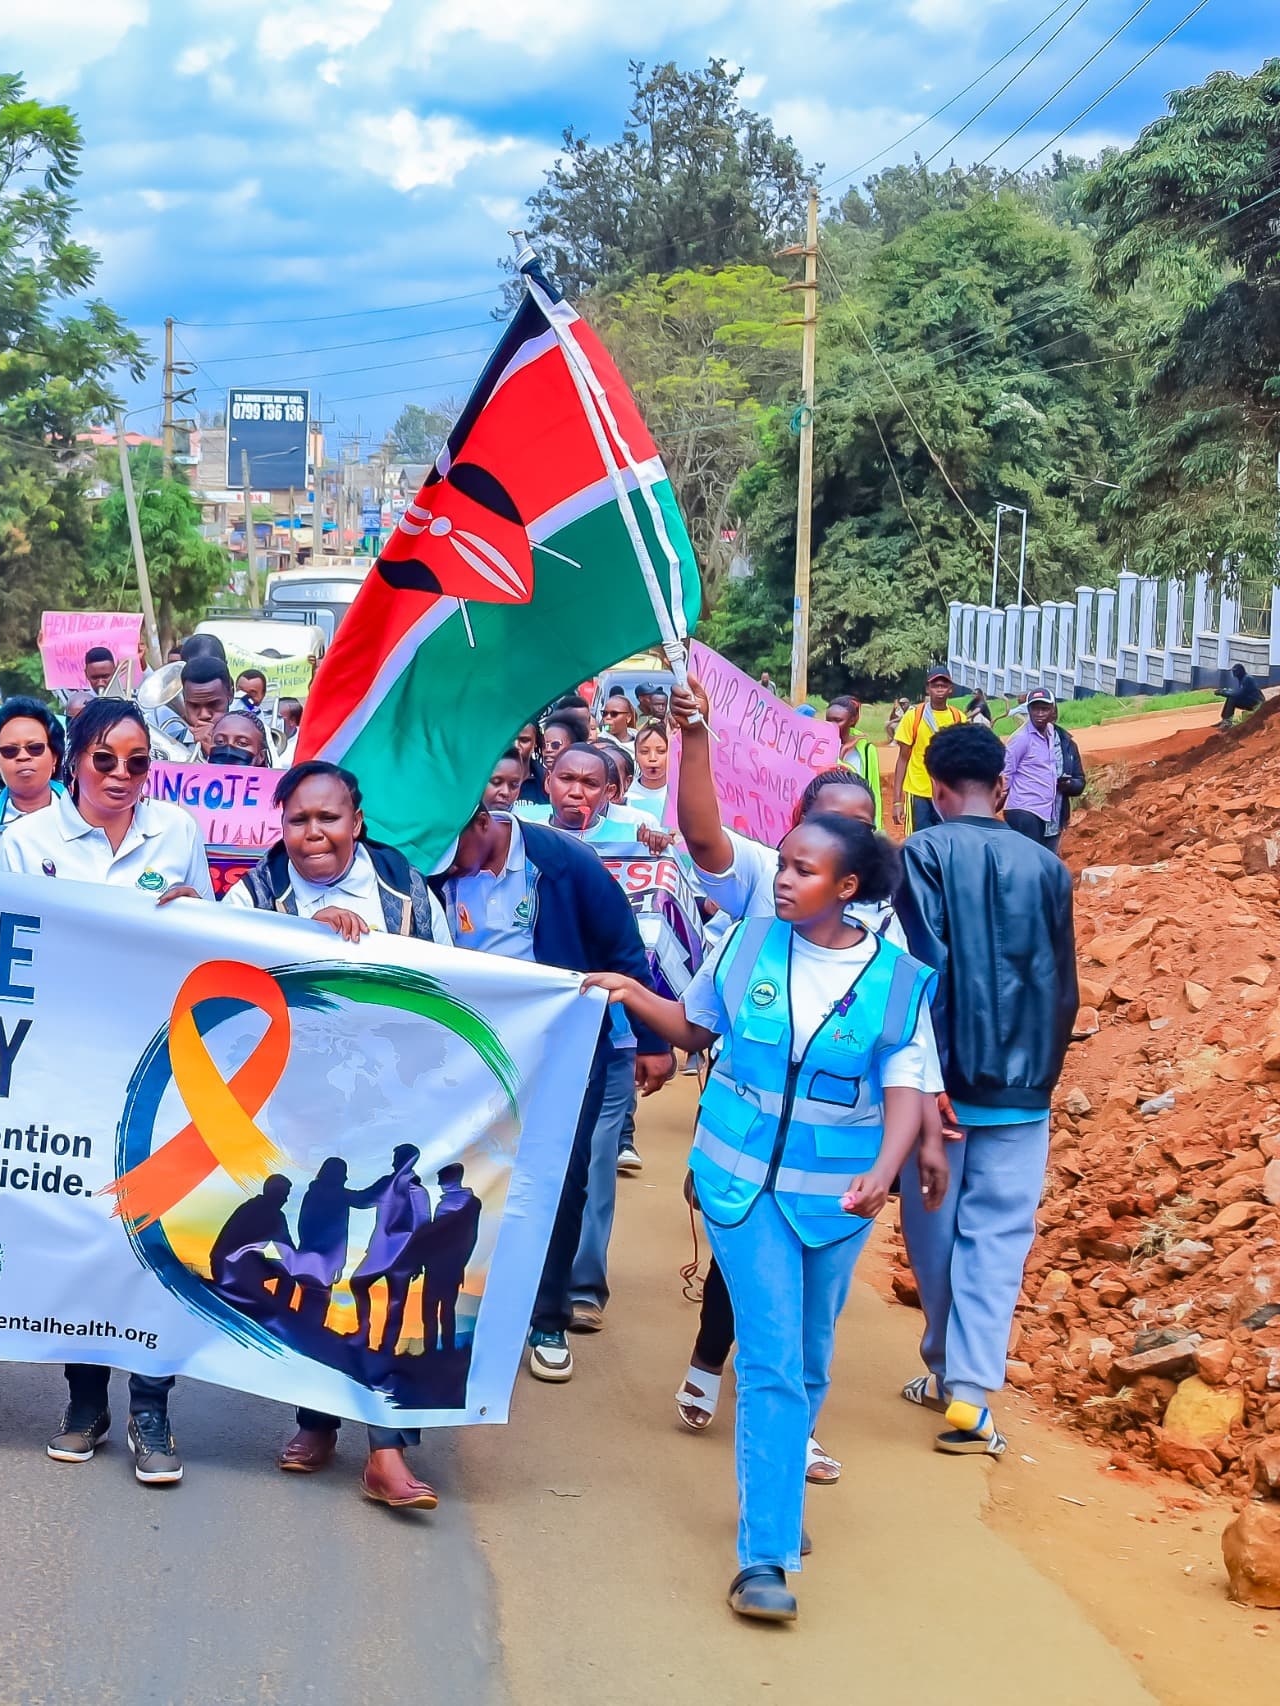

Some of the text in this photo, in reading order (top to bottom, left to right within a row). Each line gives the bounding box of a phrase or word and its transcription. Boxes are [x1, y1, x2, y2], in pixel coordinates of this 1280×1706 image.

[233, 403, 305, 421] 0799 136 136
[694, 653, 830, 774] YOUR PRESENCE
[717, 728, 742, 775] BE
[748, 791, 776, 831] TO
